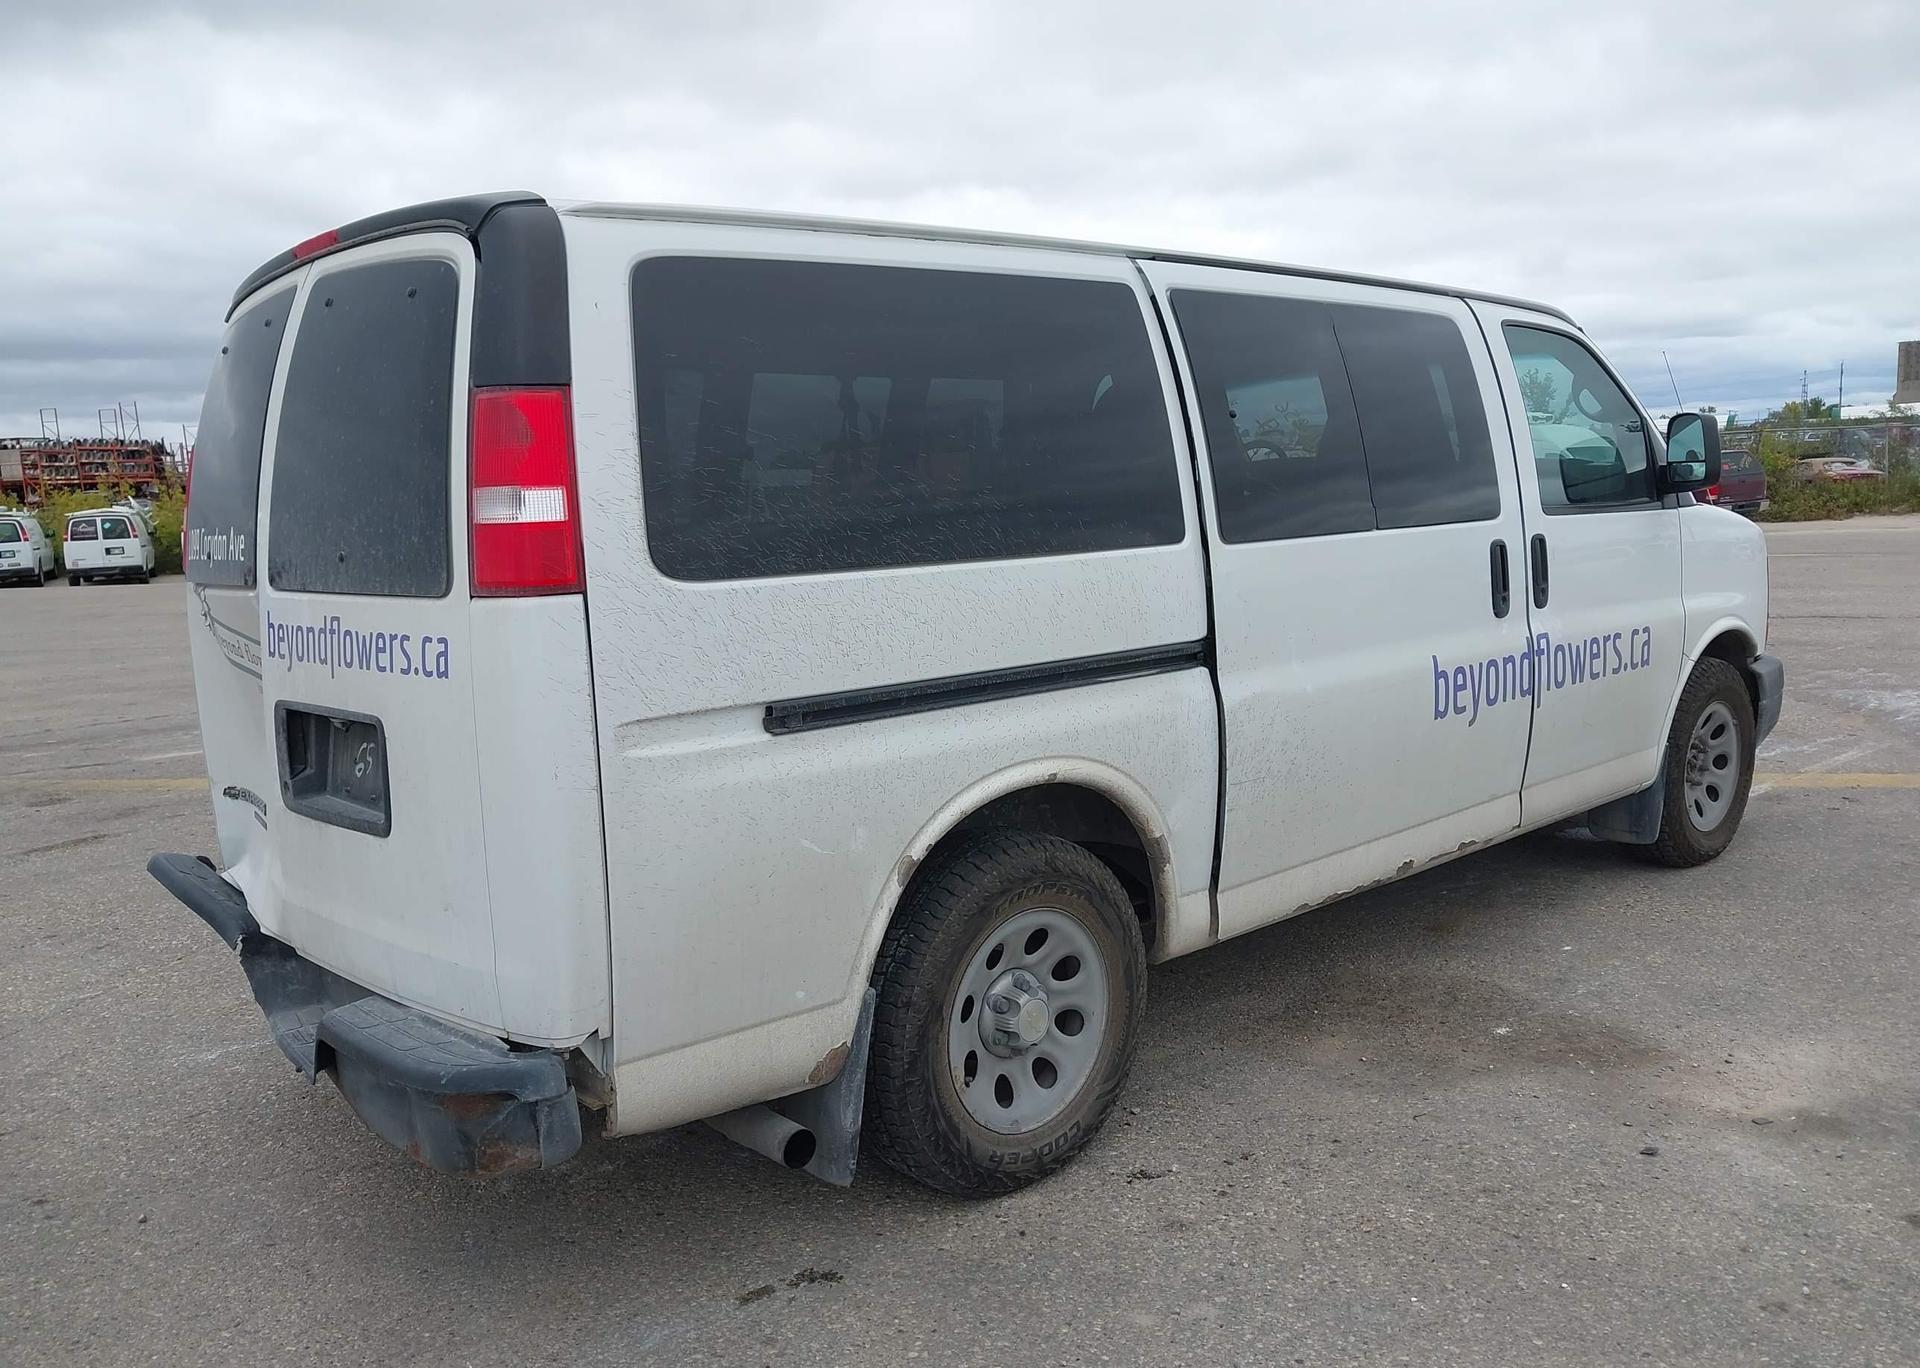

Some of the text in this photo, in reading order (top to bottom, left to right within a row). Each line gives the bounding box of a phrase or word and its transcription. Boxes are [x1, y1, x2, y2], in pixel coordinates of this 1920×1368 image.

[200, 528, 227, 568] Corydon
[229, 526, 245, 561] Ave
[267, 610, 449, 680] beyondflowers.ca
[1432, 626, 1651, 727] beyondflowers.ca
[988, 1120, 1081, 1165] COOPER
